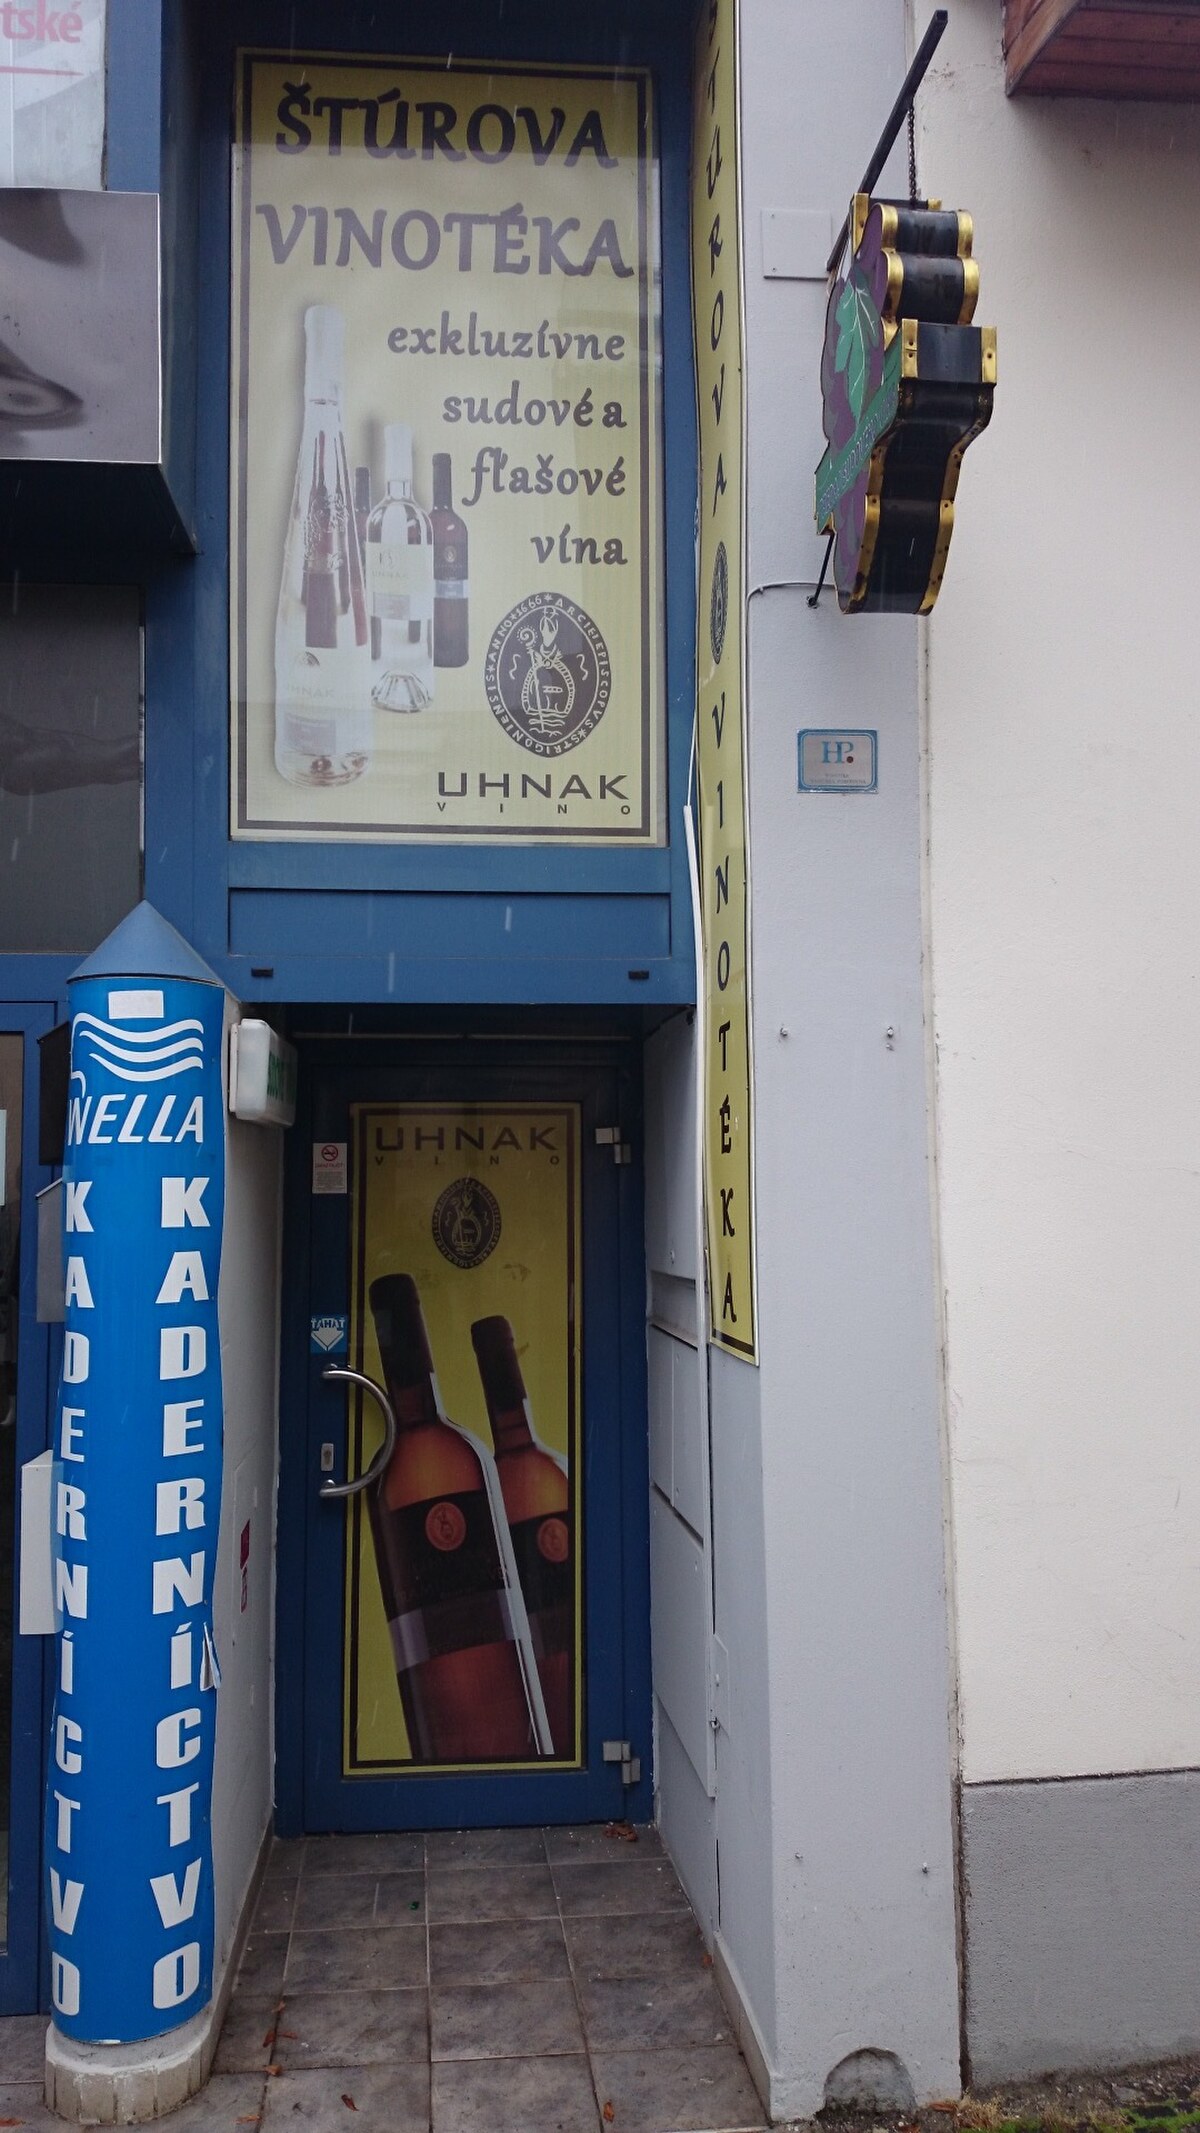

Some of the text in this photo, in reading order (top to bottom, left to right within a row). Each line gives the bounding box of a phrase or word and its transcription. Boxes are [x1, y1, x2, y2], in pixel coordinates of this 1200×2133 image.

[275, 81, 620, 169] ŠTÚROVA
[255, 202, 635, 279] VINOTÉKA
[387, 310, 626, 361] exkluzívne
[442, 379, 628, 429] sudové a
[461, 446, 627, 507] fľašové
[530, 523, 628, 566] vína
[437, 771, 630, 801] UHNAK
[437, 801, 631, 816] VINO
[712, 691, 737, 1323] VINOTÉKA
[67, 1094, 205, 1147] WELLA
[375, 1126, 558, 1152] UHNAK
[50, 1180, 95, 2017] KADERNÍCTVO
[150, 1177, 211, 2011] KADERNÍCTVO
